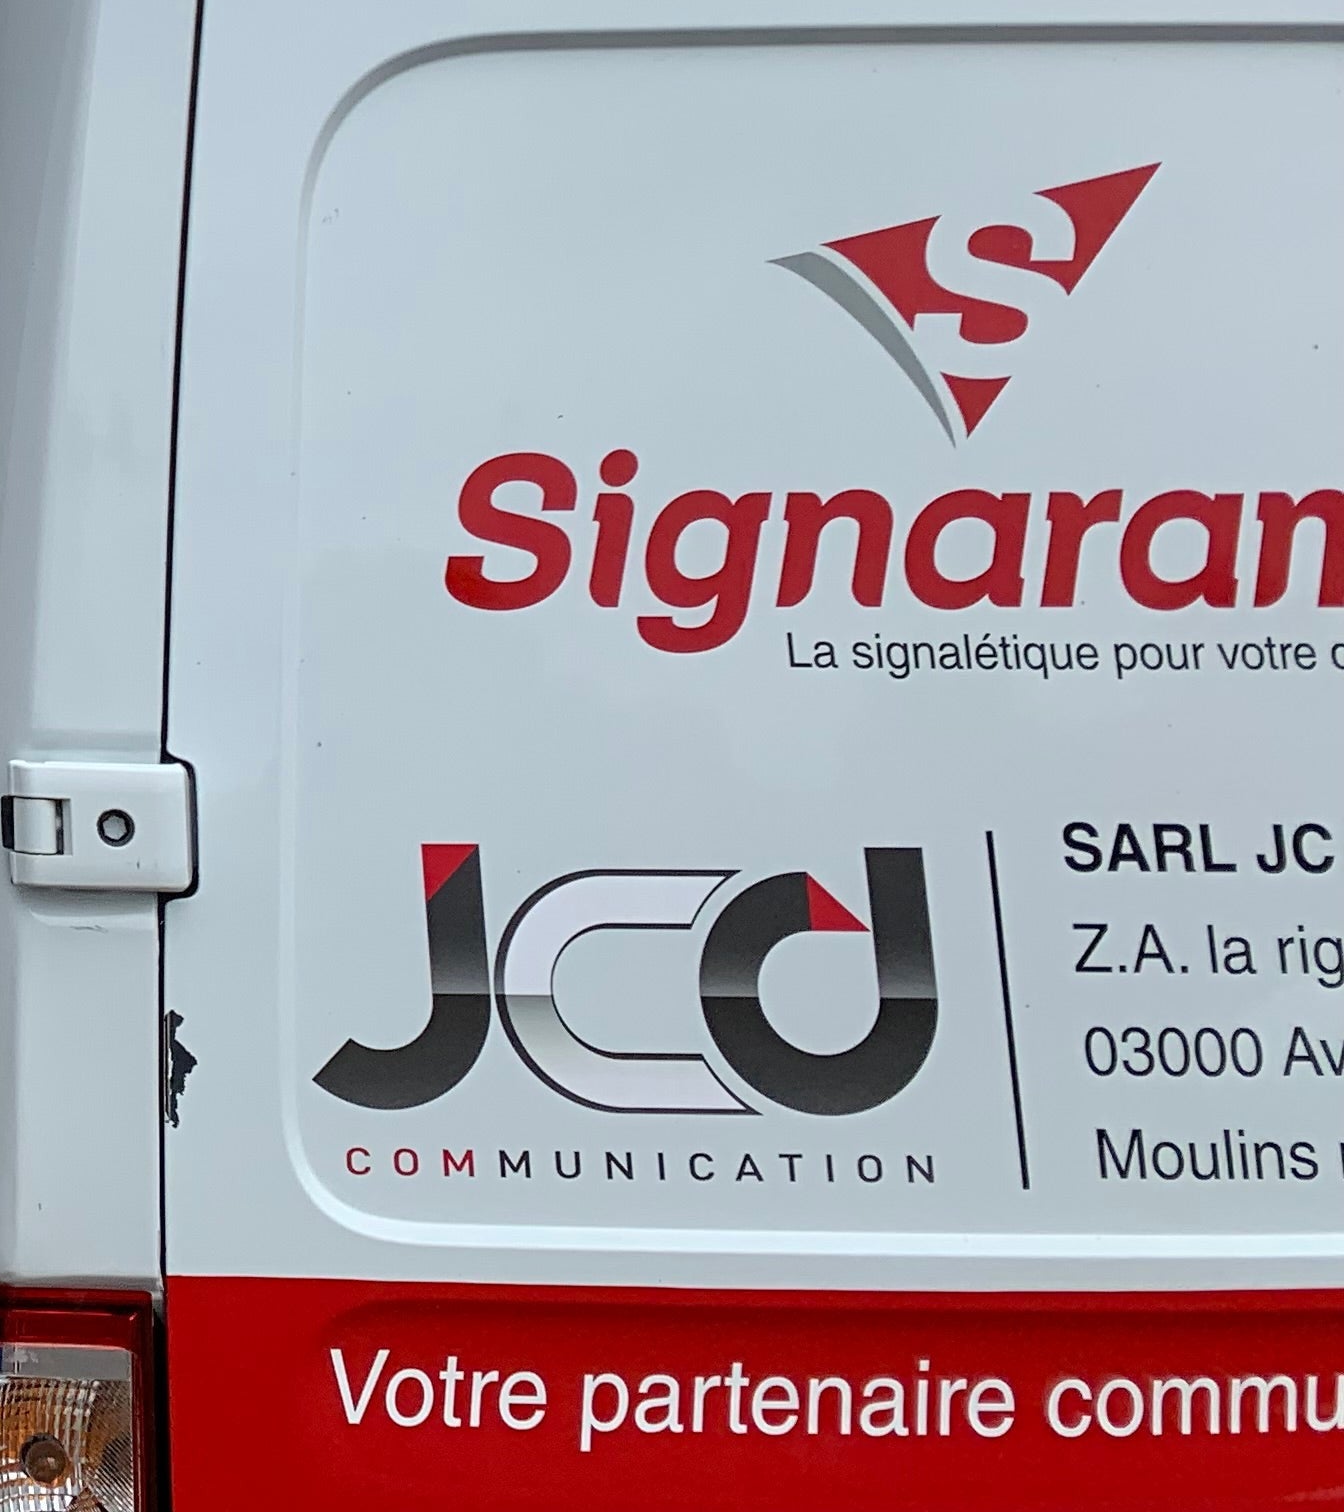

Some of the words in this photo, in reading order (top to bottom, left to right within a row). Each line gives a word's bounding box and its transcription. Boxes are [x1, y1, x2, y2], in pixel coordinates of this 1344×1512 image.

[787, 633, 838, 668] La
[853, 633, 1099, 679] signalétique
[1114, 643, 1204, 679] pour
[1218, 637, 1316, 669] votre
[1063, 822, 1236, 872] SARL
[1257, 823, 1334, 873] JC
[1073, 924, 1188, 973] Z.A.
[1207, 925, 1256, 974] la
[1085, 1027, 1262, 1077] 03000
[347, 1148, 934, 1183] COMMUNICATION
[1096, 1129, 1318, 1180] Moulins
[331, 1349, 546, 1429] Votre
[581, 1360, 1014, 1451] partenaire
[1048, 1374, 1344, 1437] commu
